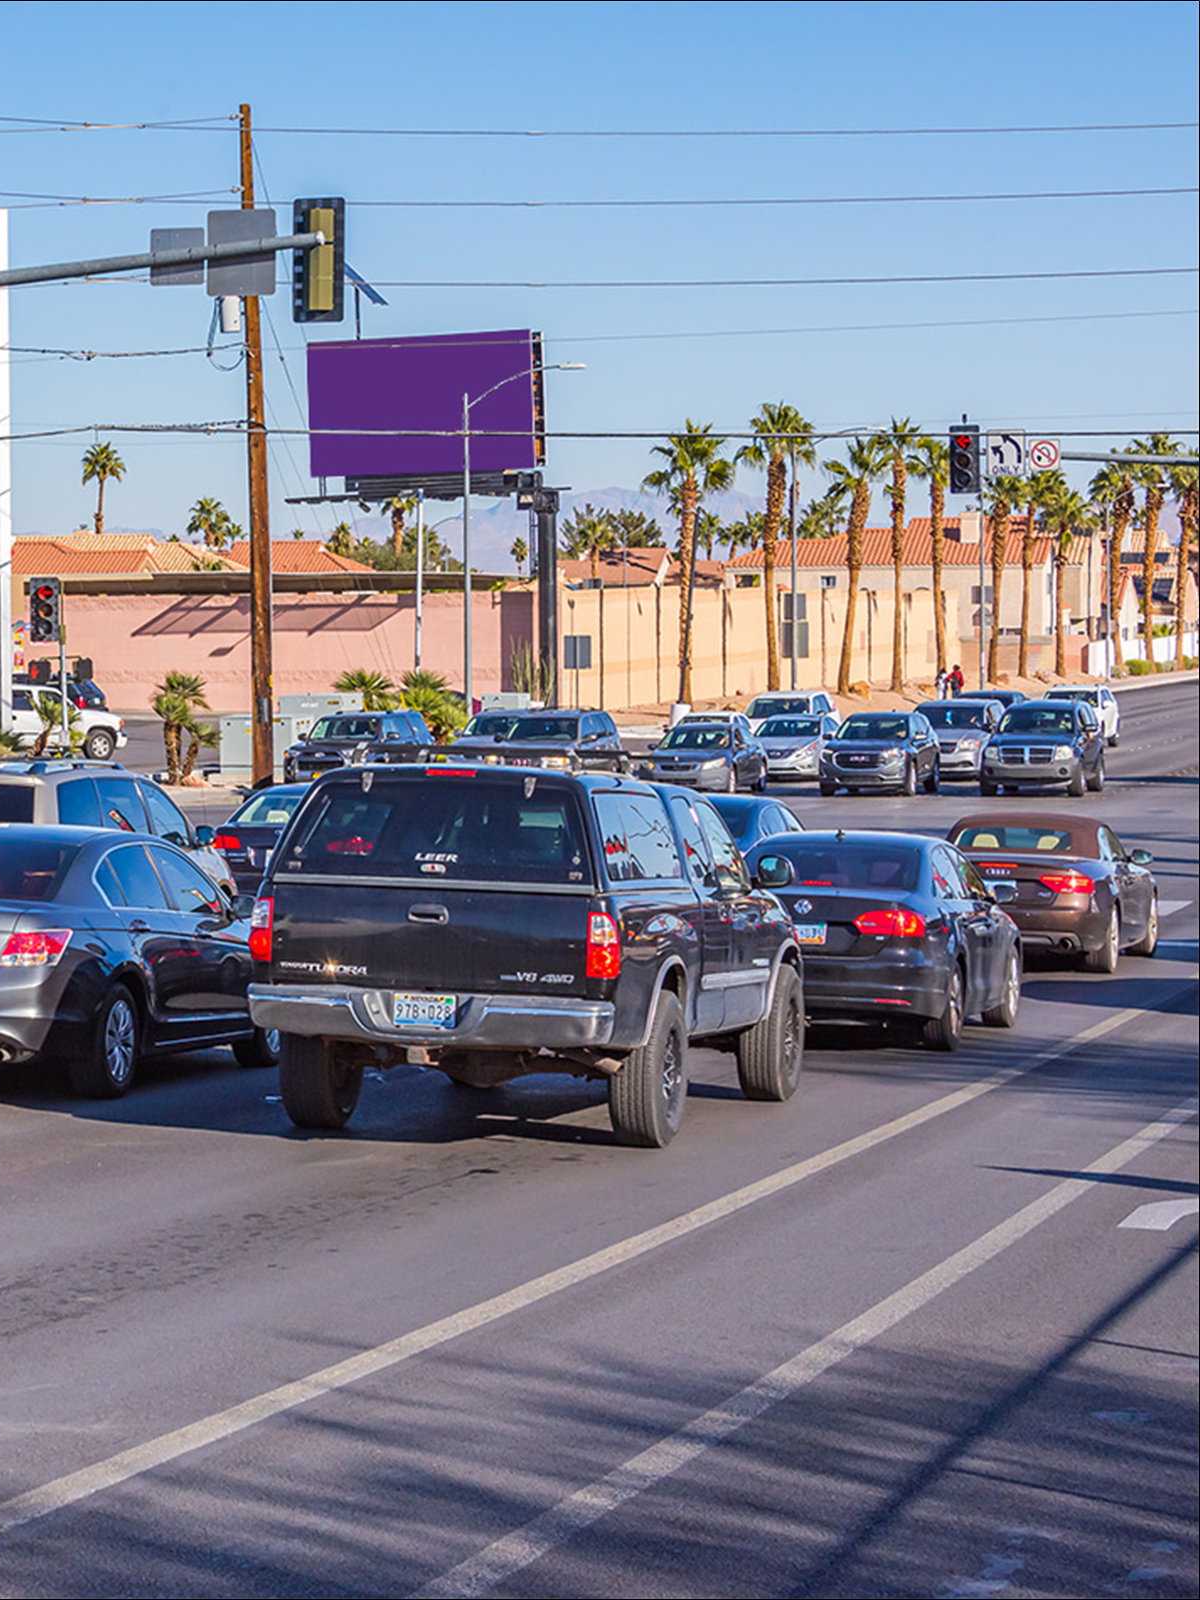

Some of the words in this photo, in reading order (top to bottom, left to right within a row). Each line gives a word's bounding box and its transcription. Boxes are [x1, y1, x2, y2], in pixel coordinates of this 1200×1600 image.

[992, 465, 1021, 474] ONLY
[414, 852, 458, 863] LEER
[307, 963, 368, 976] TUNDRA
